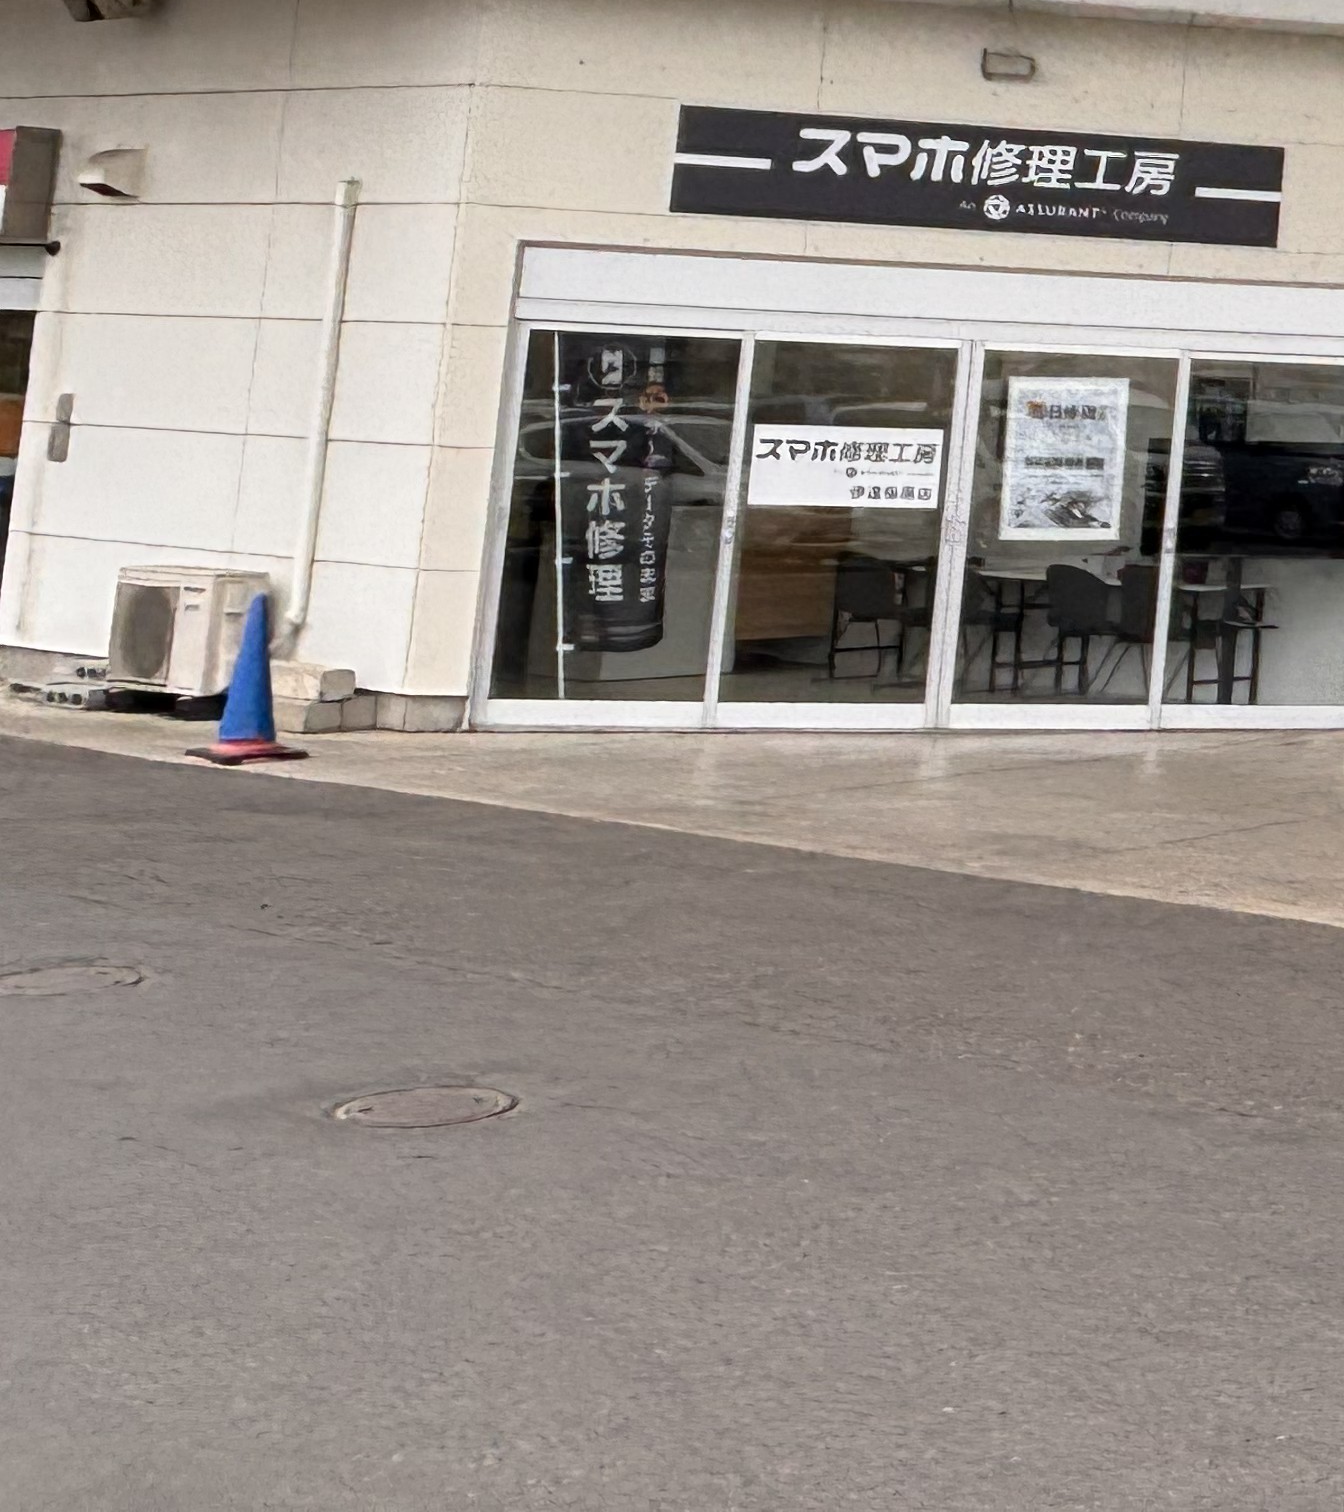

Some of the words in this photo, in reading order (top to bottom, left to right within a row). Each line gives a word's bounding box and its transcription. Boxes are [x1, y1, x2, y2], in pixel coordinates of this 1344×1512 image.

[791, 128, 1181, 197] スマホ修理工房
[756, 438, 939, 464] スマホ修理工房
[586, 397, 629, 602] スマホ修理
